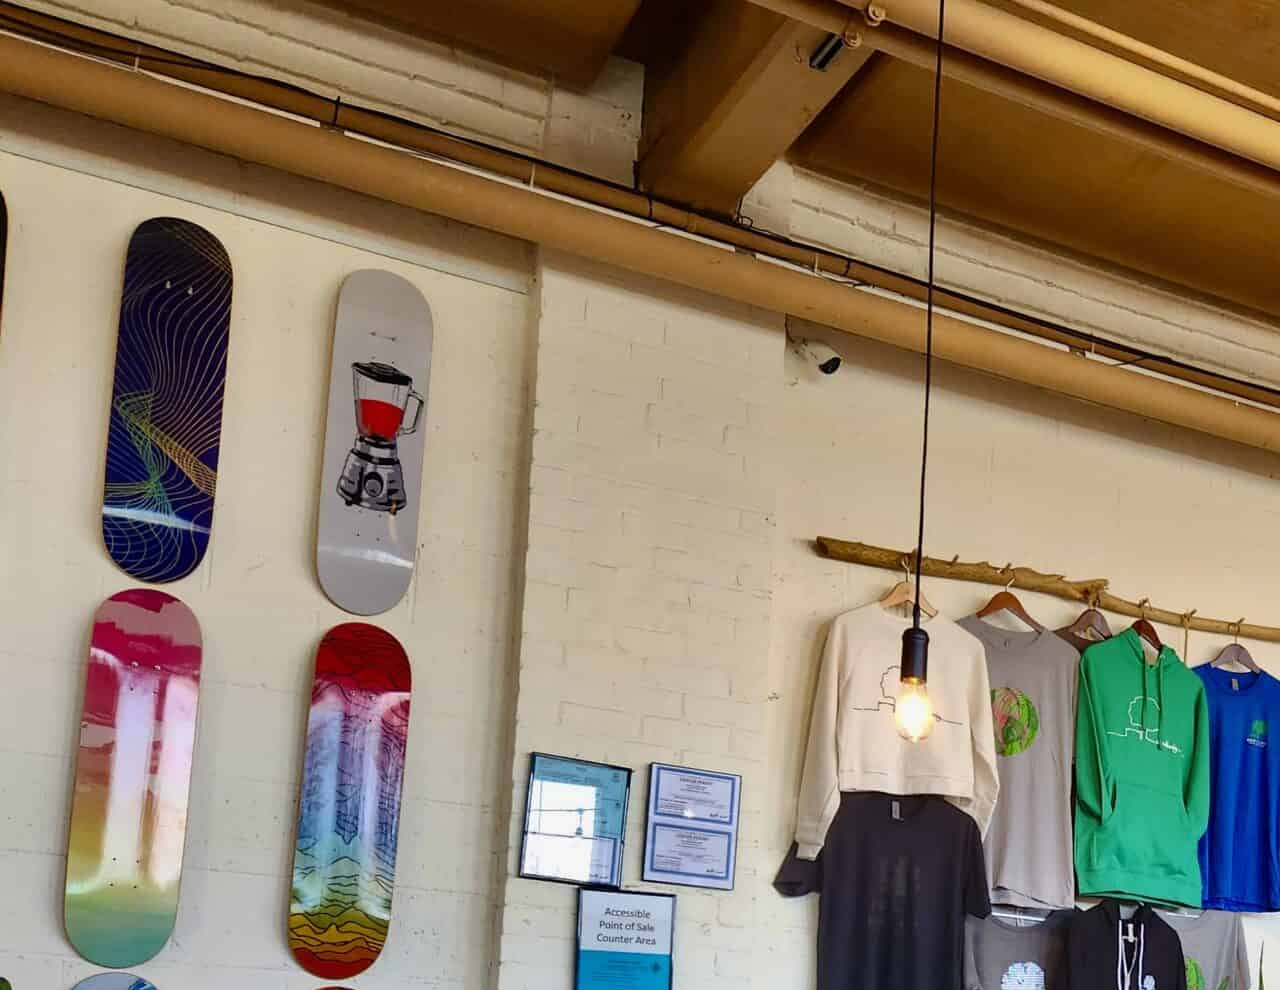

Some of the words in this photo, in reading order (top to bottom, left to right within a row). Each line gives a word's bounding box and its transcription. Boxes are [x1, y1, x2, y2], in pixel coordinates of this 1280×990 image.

[605, 907, 651, 920] Accessible
[599, 920, 623, 931] Point
[624, 921, 635, 931] of
[637, 922, 655, 933] Sale
[596, 933, 633, 944] Counter
[634, 935, 657, 946] Area
